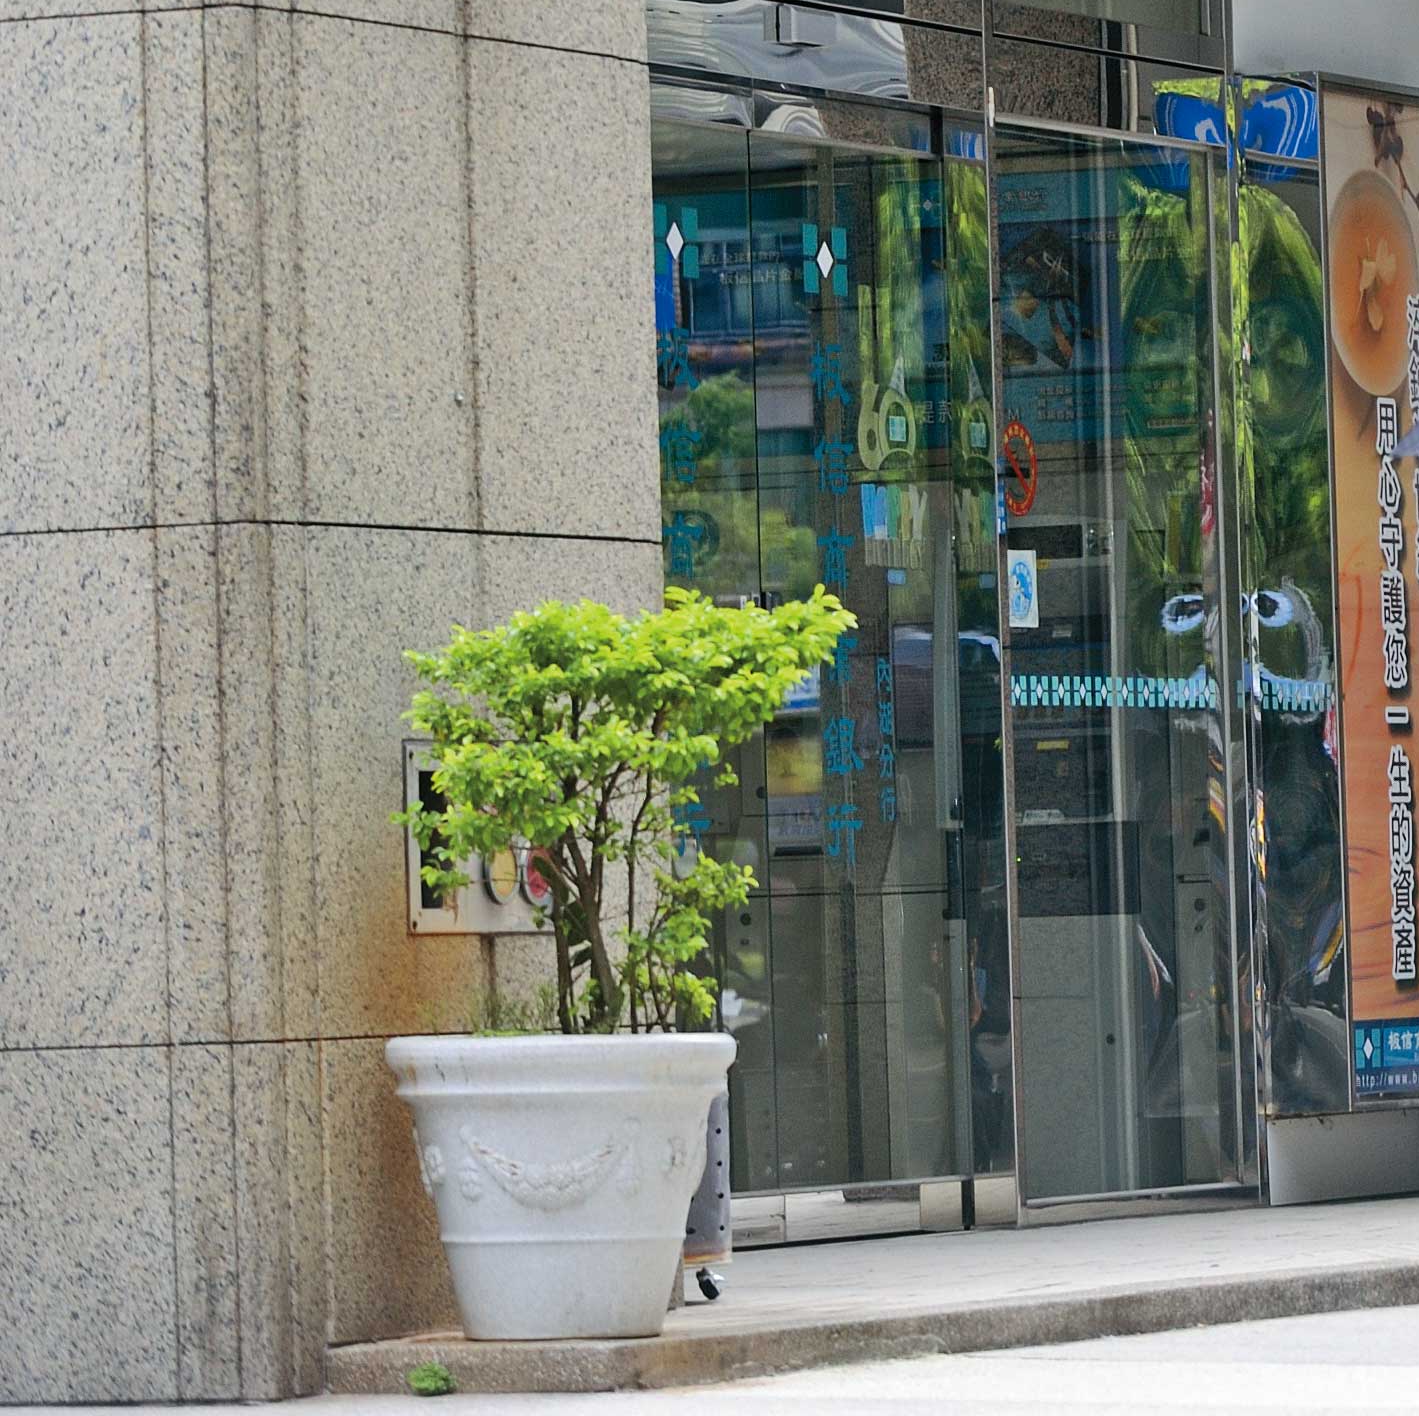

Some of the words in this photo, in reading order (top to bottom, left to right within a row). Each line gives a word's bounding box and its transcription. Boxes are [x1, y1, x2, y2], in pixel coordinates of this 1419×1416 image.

[1377, 397, 1416, 981] 用心守護您一生的資產
